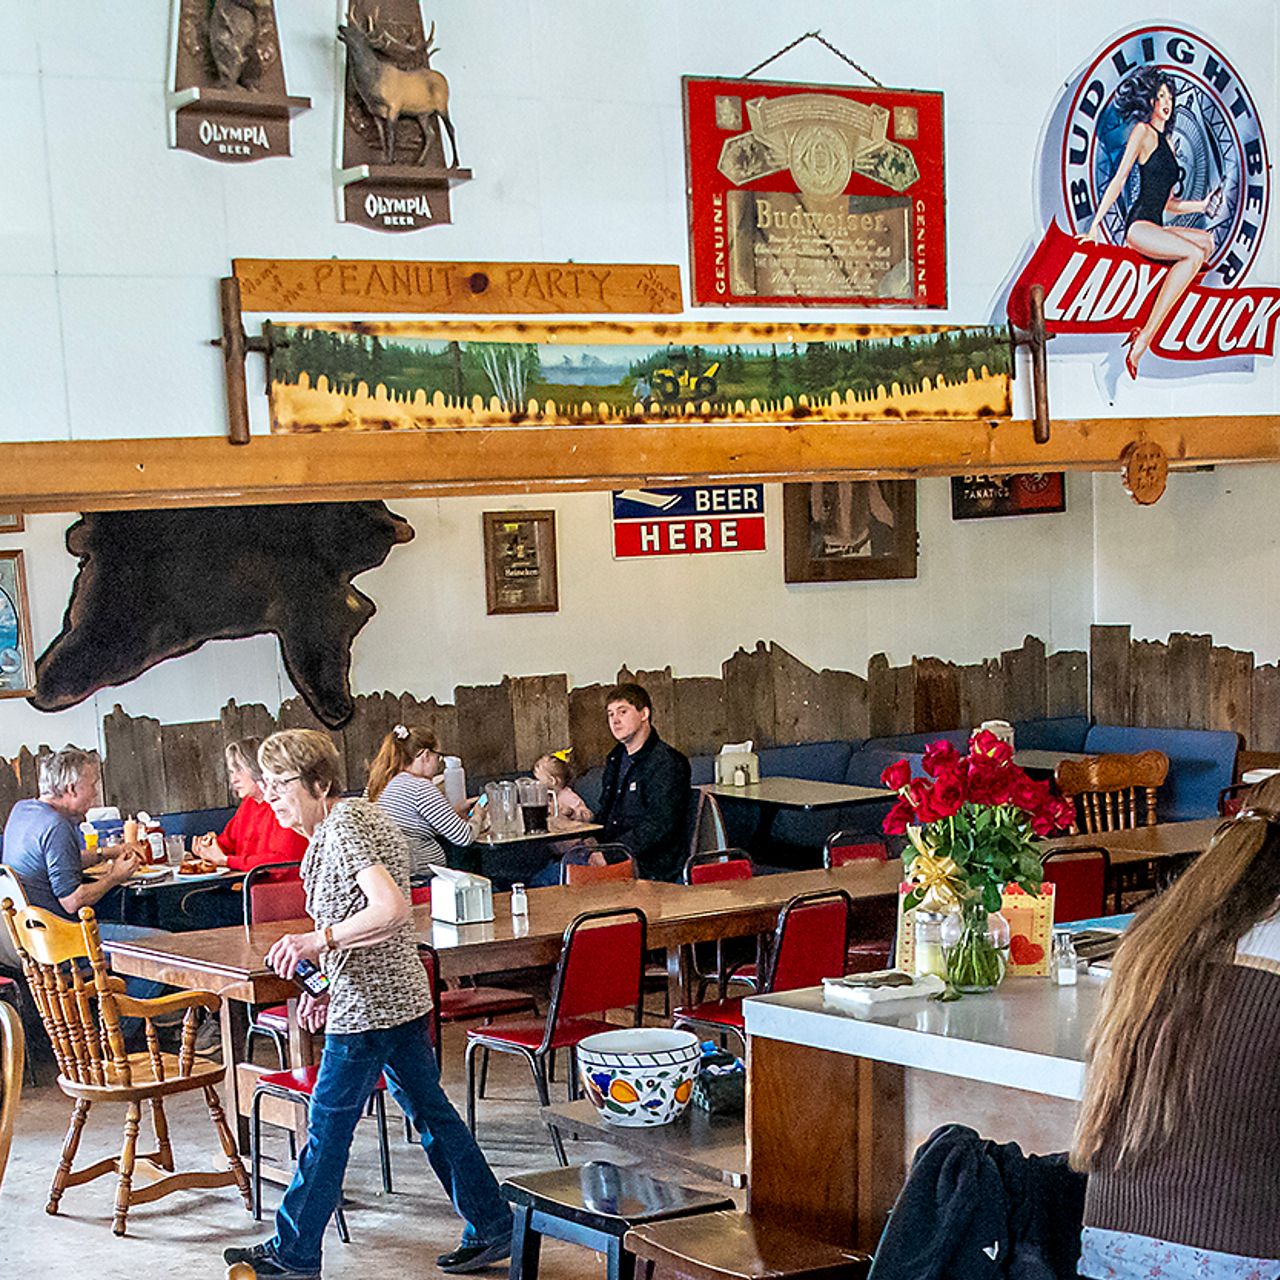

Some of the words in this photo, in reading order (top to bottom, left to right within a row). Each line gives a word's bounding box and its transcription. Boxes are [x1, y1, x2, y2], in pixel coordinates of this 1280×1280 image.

[199, 119, 270, 149] OLYMPIA
[219, 144, 252, 155] BEER
[1069, 79, 1105, 221] BUD
[1112, 36, 1252, 120] LIGHT
[1222, 138, 1264, 286] BEER
[365, 193, 433, 219] OLYMPIA
[383, 215, 416, 226] BEER
[713, 192, 727, 295] GENUINE
[915, 200, 927, 299] GENUINE
[313, 264, 457, 299] PEANUT
[506, 267, 613, 301] PARTY
[1043, 251, 1169, 322] LADY
[696, 488, 758, 512] BEER
[640, 520, 738, 552] HERE
